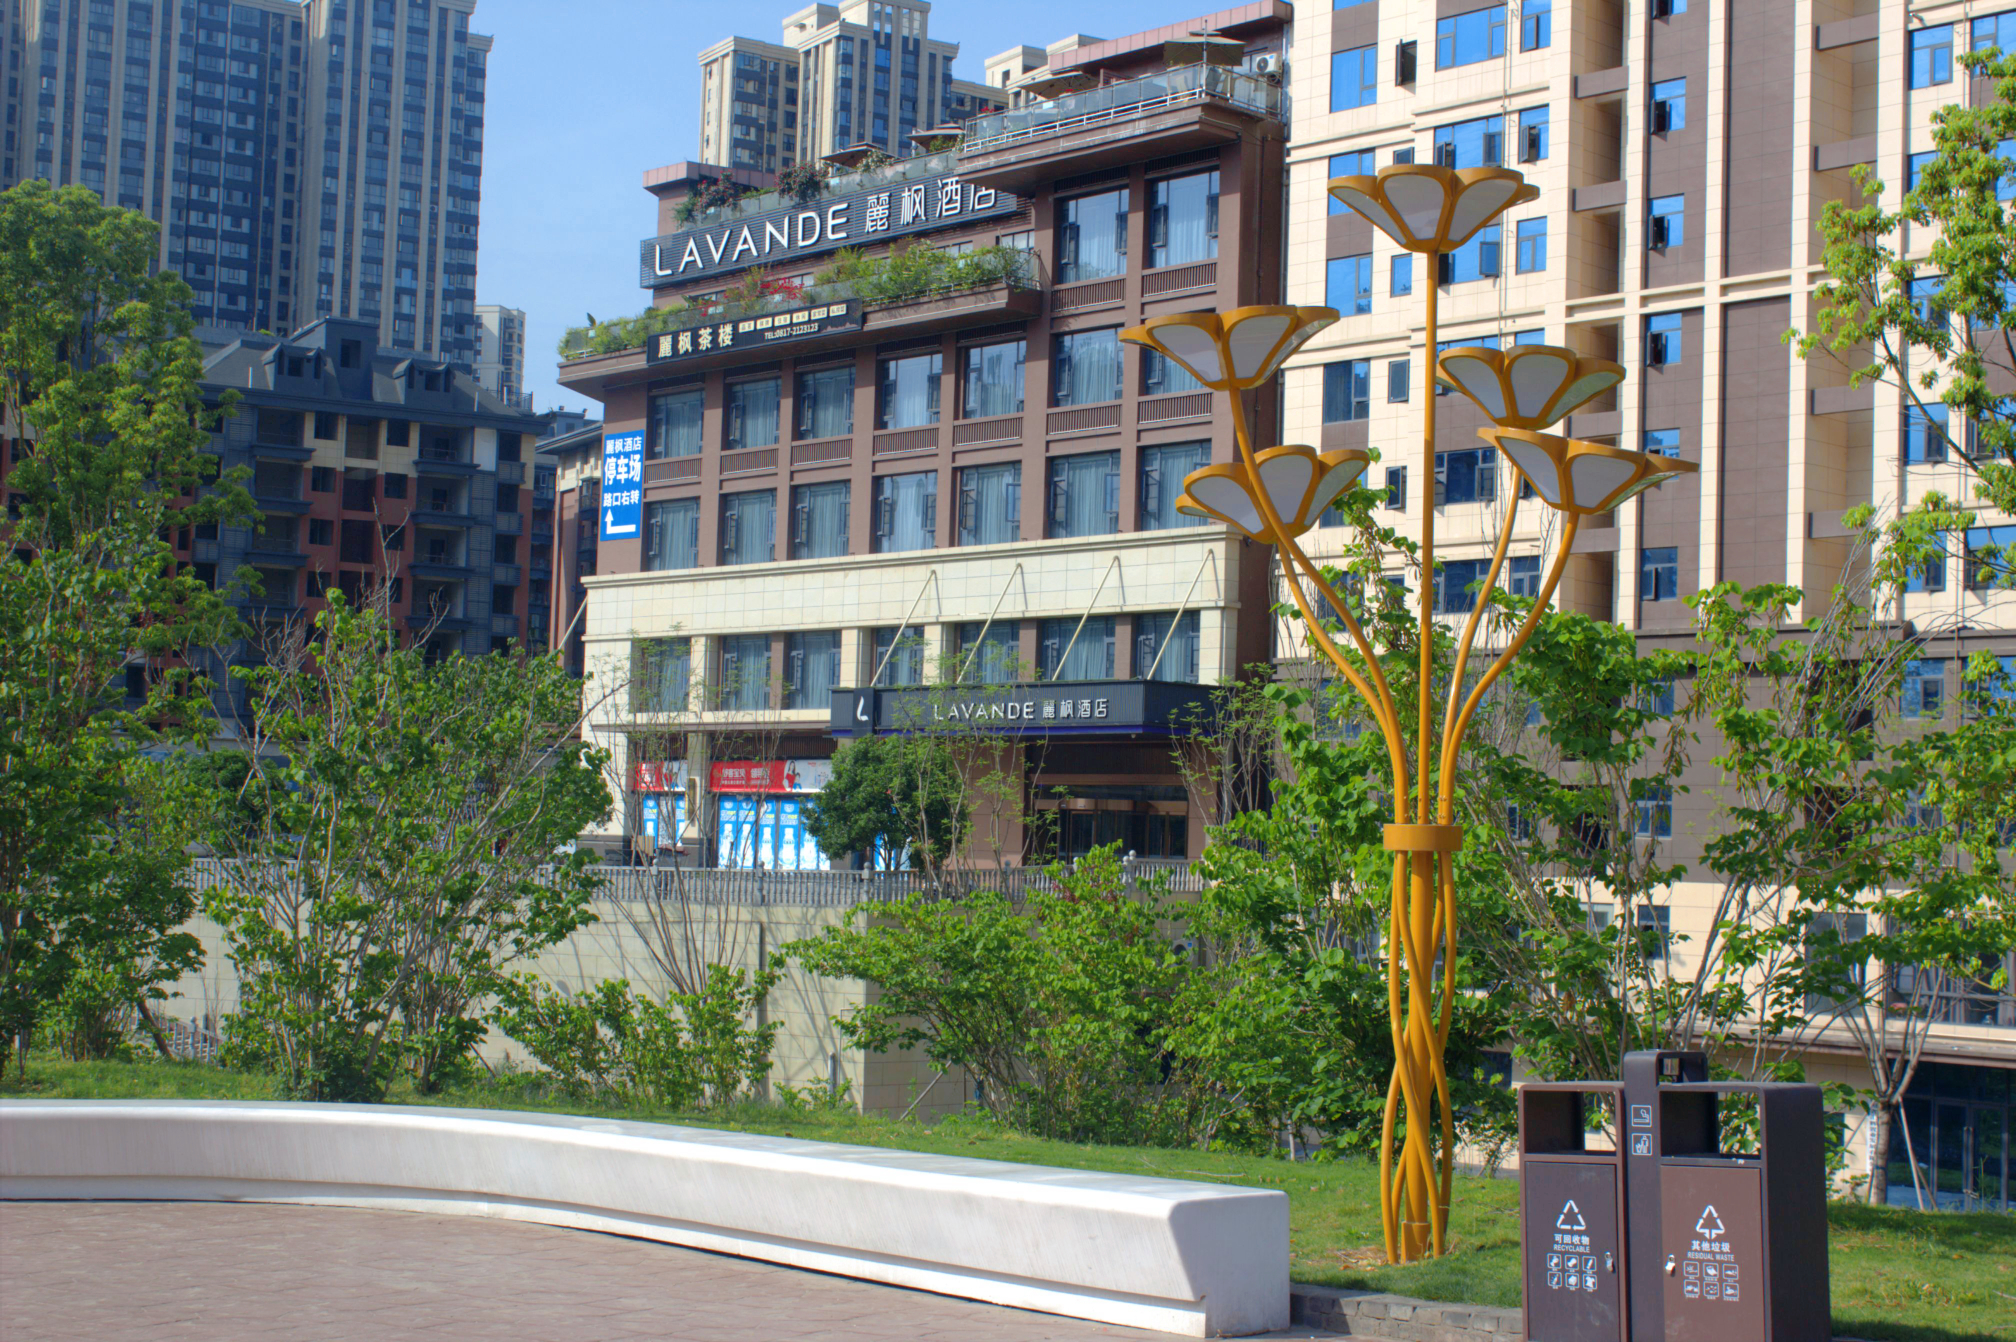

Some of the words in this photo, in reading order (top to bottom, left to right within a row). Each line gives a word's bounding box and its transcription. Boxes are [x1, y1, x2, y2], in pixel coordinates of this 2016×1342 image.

[655, 203, 849, 276] LAVANDE
[658, 323, 733, 358] 麗枫茶楼
[604, 454, 642, 485] 停车场
[603, 490, 640, 507] 路口右转
[934, 702, 1034, 720] LAVANDE
[1043, 698, 1107, 719] 麗枫酒店
[1553, 1233, 1590, 1245] 可回收物
[1691, 1239, 1731, 1252] 其他垃圾
[1553, 1244, 1590, 1253] RECYCLABLE
[1687, 1251, 1714, 1260] RESIDUAL
[1715, 1253, 1735, 1262] WASTE
